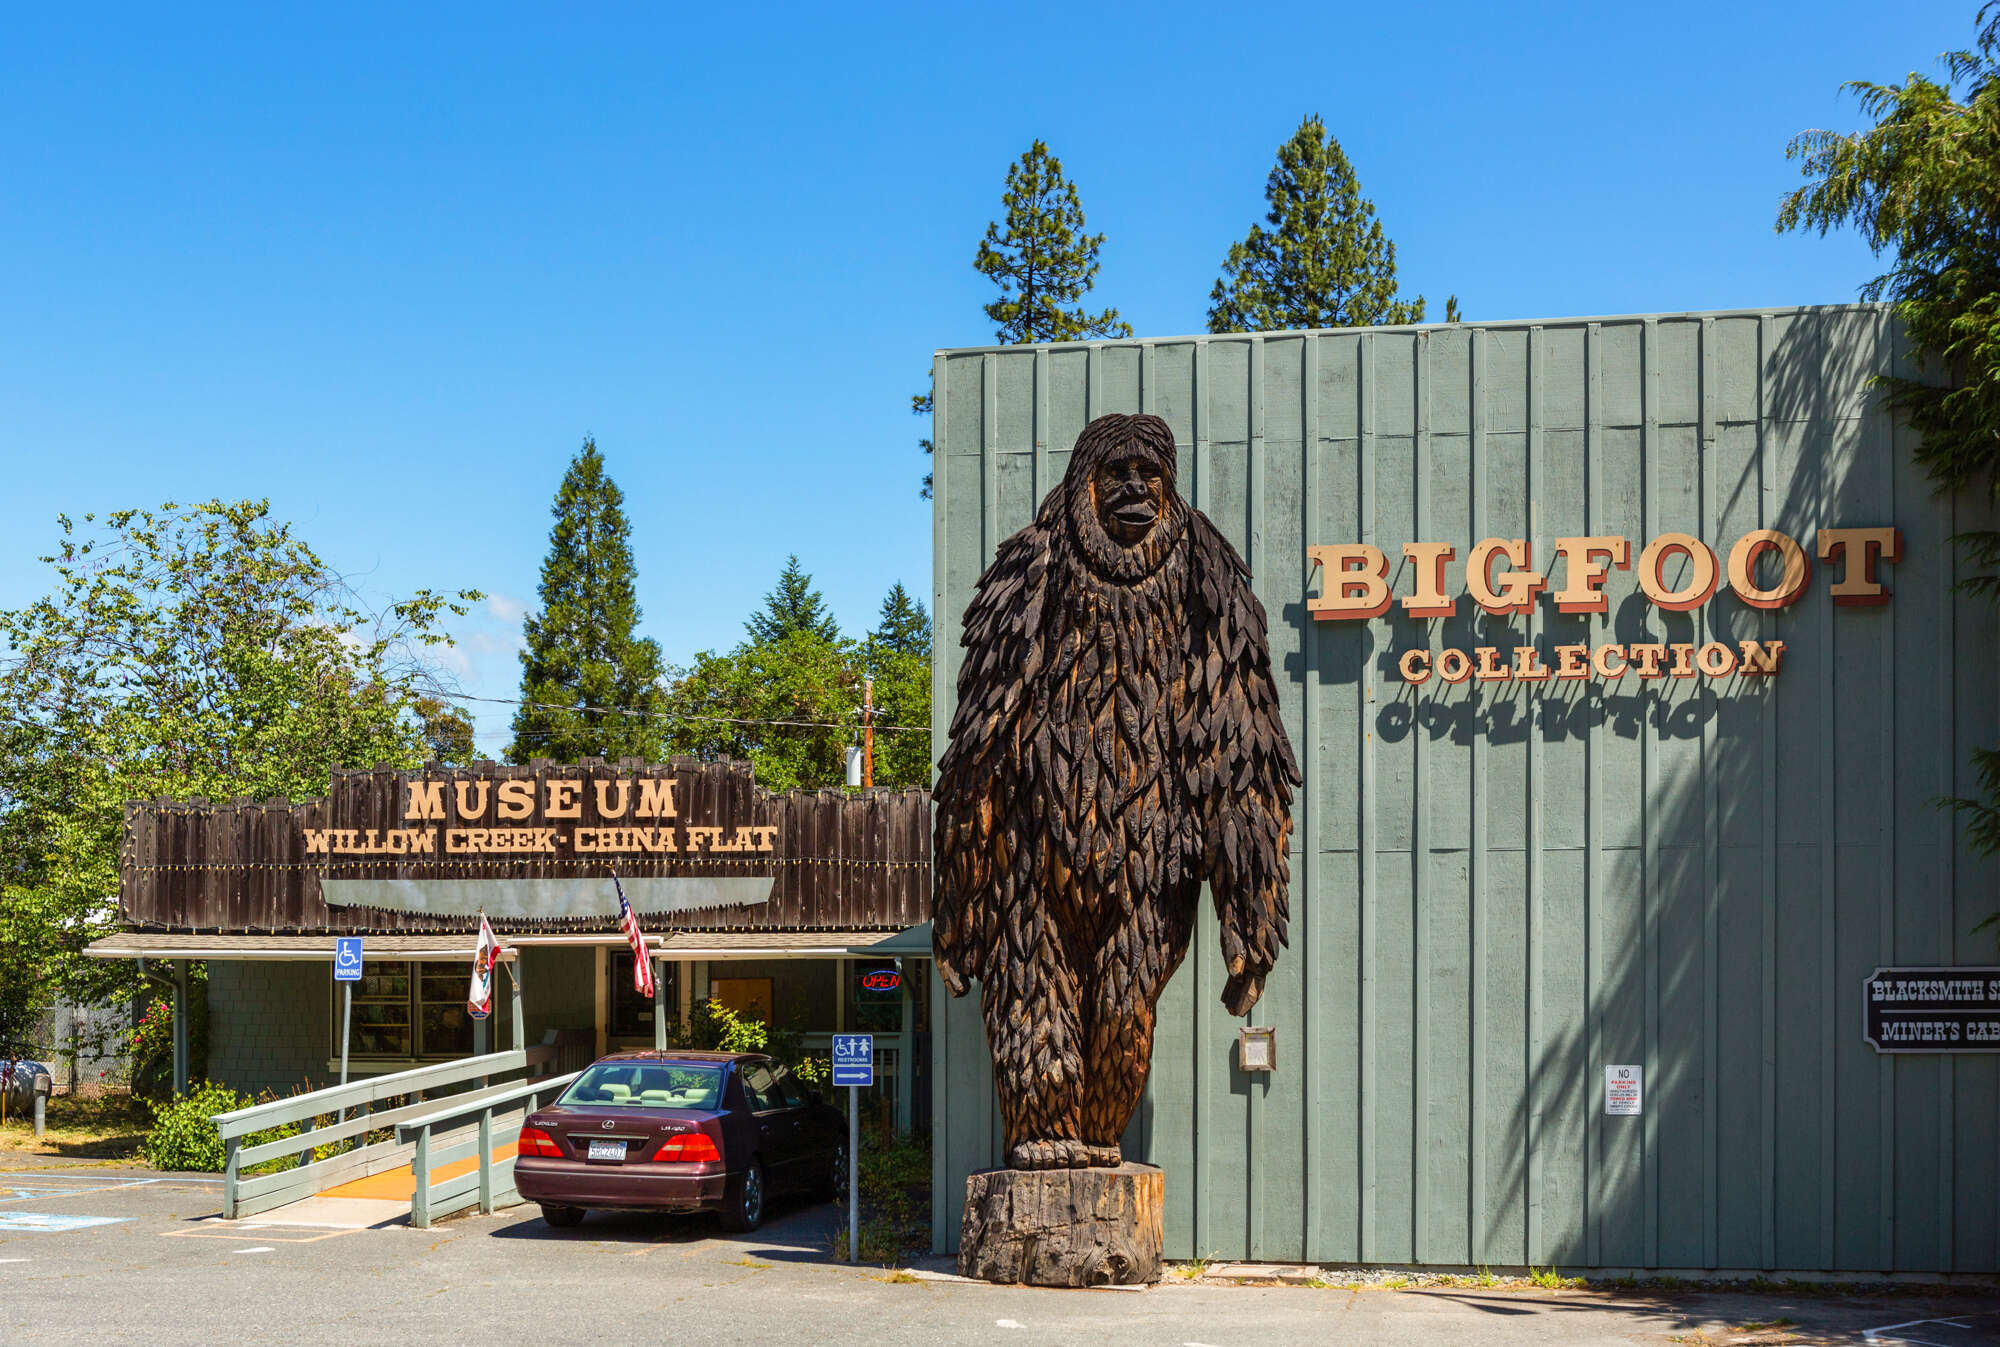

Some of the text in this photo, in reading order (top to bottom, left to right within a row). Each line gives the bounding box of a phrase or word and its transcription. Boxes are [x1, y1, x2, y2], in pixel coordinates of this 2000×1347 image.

[1306, 527, 1901, 620] BIGFOOT
[1398, 640, 1787, 685] COLLECTION
[405, 779, 678, 819] MUSEUM
[304, 827, 437, 854] WILLOW
[686, 826, 778, 851] FLAT
[336, 968, 360, 976] PARKING
[862, 975, 901, 987] OPEN
[1872, 980, 1985, 1001] BLACKSMITH
[1881, 1022, 1960, 1041] MINER'S
[1618, 1069, 1630, 1079] NO
